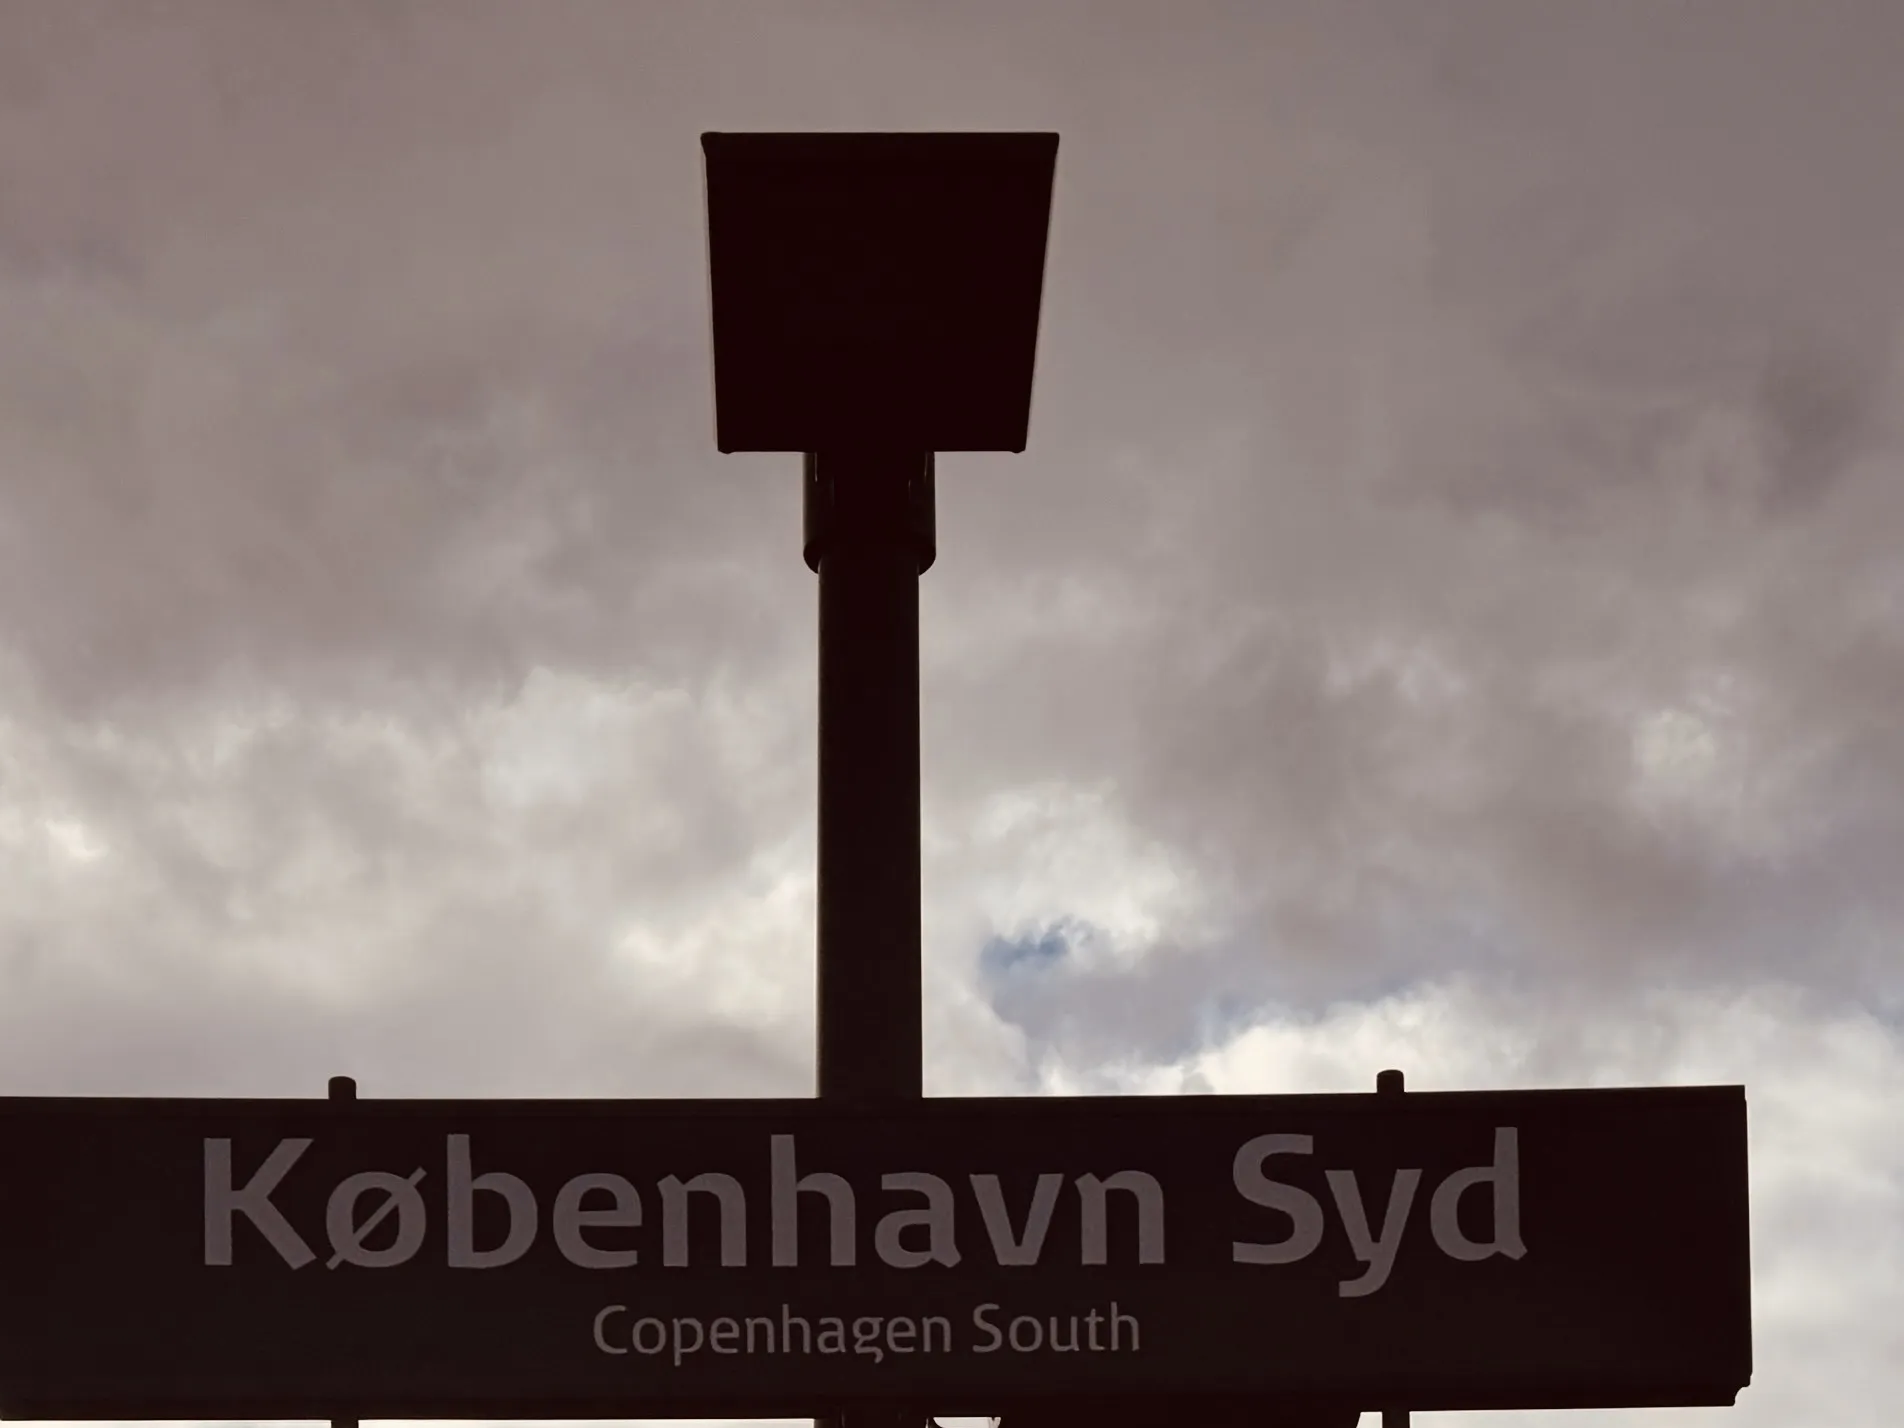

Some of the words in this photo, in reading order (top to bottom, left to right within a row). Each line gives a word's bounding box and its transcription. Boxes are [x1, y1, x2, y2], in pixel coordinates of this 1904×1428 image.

[201, 1131, 1166, 1272] København
[1231, 1125, 1529, 1299] Syd
[592, 1302, 951, 1367] Copenhagen
[971, 1300, 1141, 1353] South
